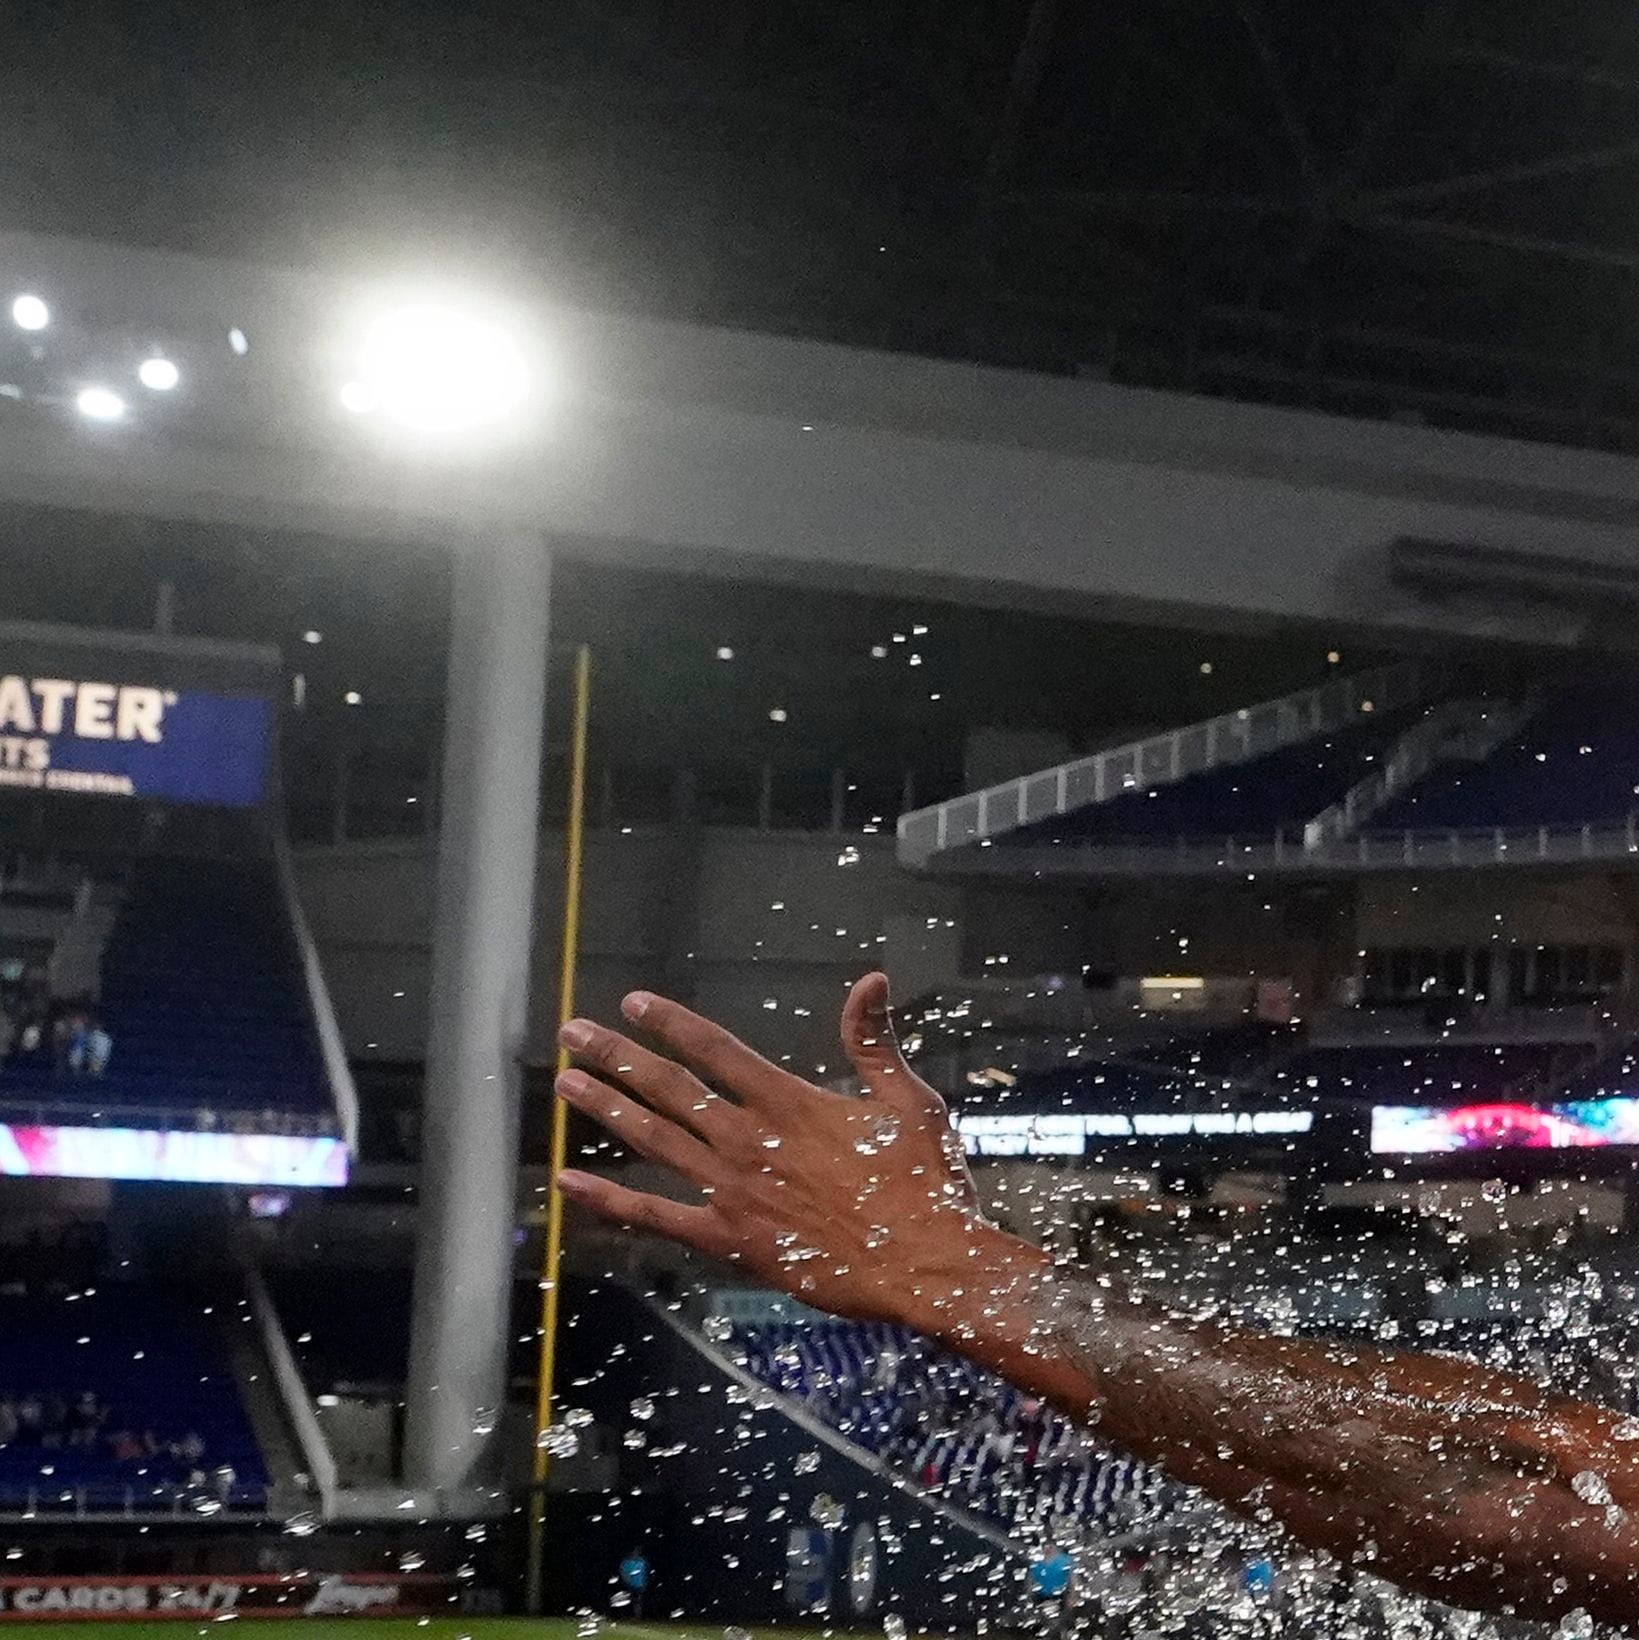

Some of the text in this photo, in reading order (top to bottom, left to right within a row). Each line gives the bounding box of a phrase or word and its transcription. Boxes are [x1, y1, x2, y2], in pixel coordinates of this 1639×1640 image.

[0, 675, 163, 743] ATER
[0, 735, 49, 769] TS
[14, 1586, 147, 1612] CARDS
